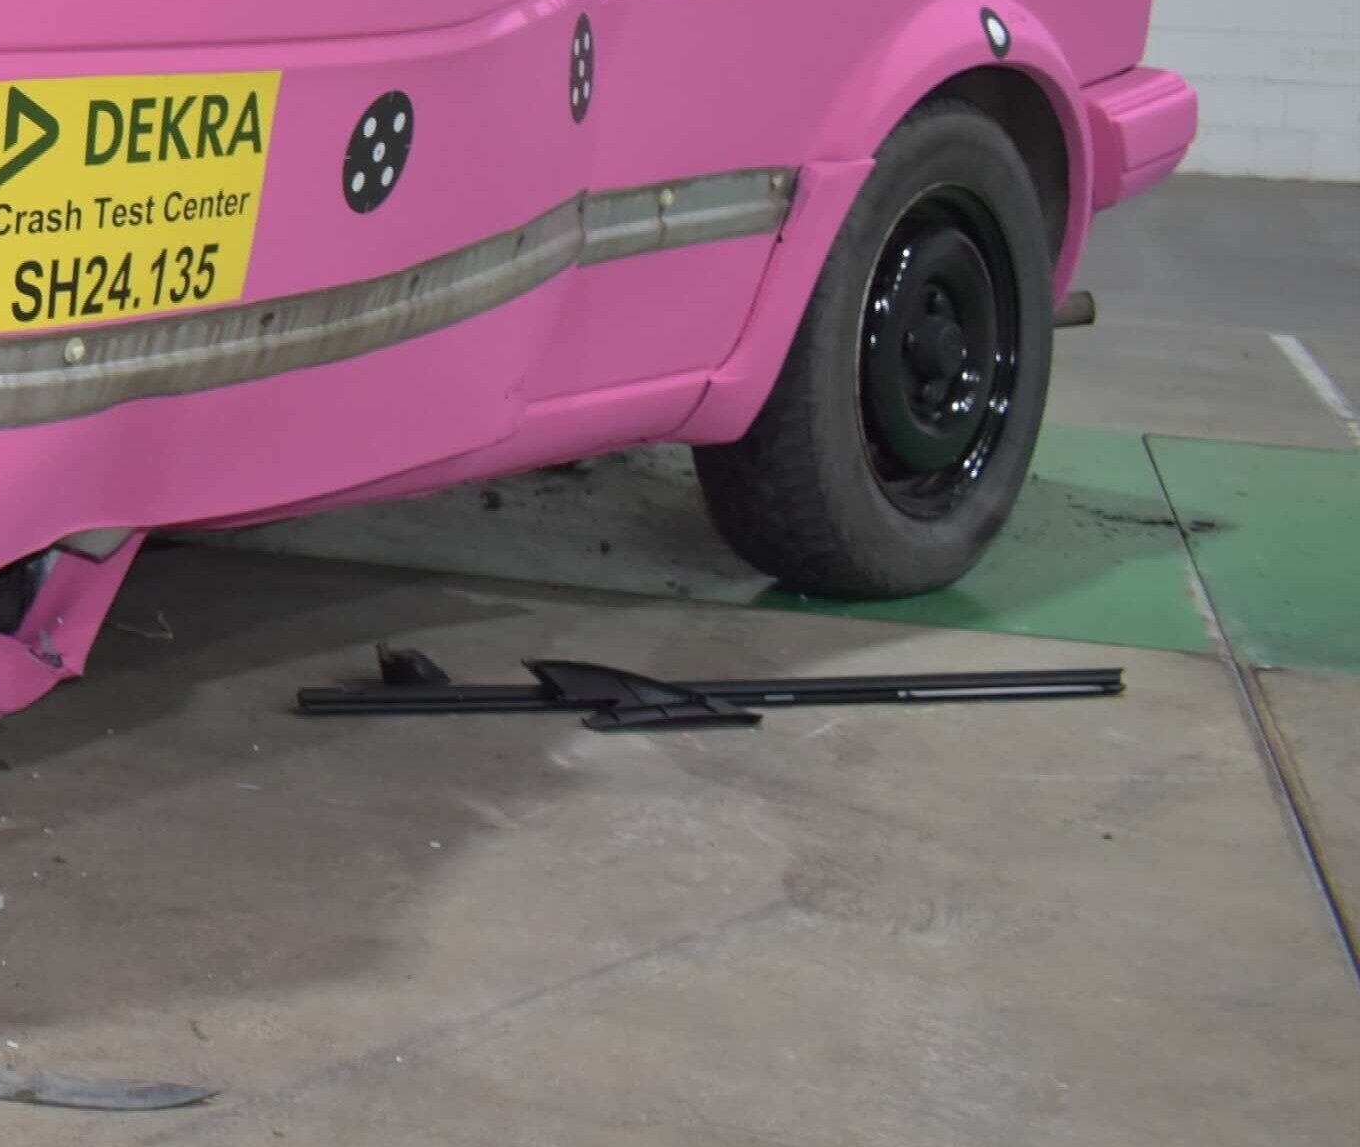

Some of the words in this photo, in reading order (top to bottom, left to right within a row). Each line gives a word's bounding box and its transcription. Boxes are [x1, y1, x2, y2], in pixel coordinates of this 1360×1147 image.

[84, 91, 263, 167] DEKRA
[94, 196, 155, 229] Test
[163, 189, 251, 223] Center
[11, 243, 219, 322] SH24.135
